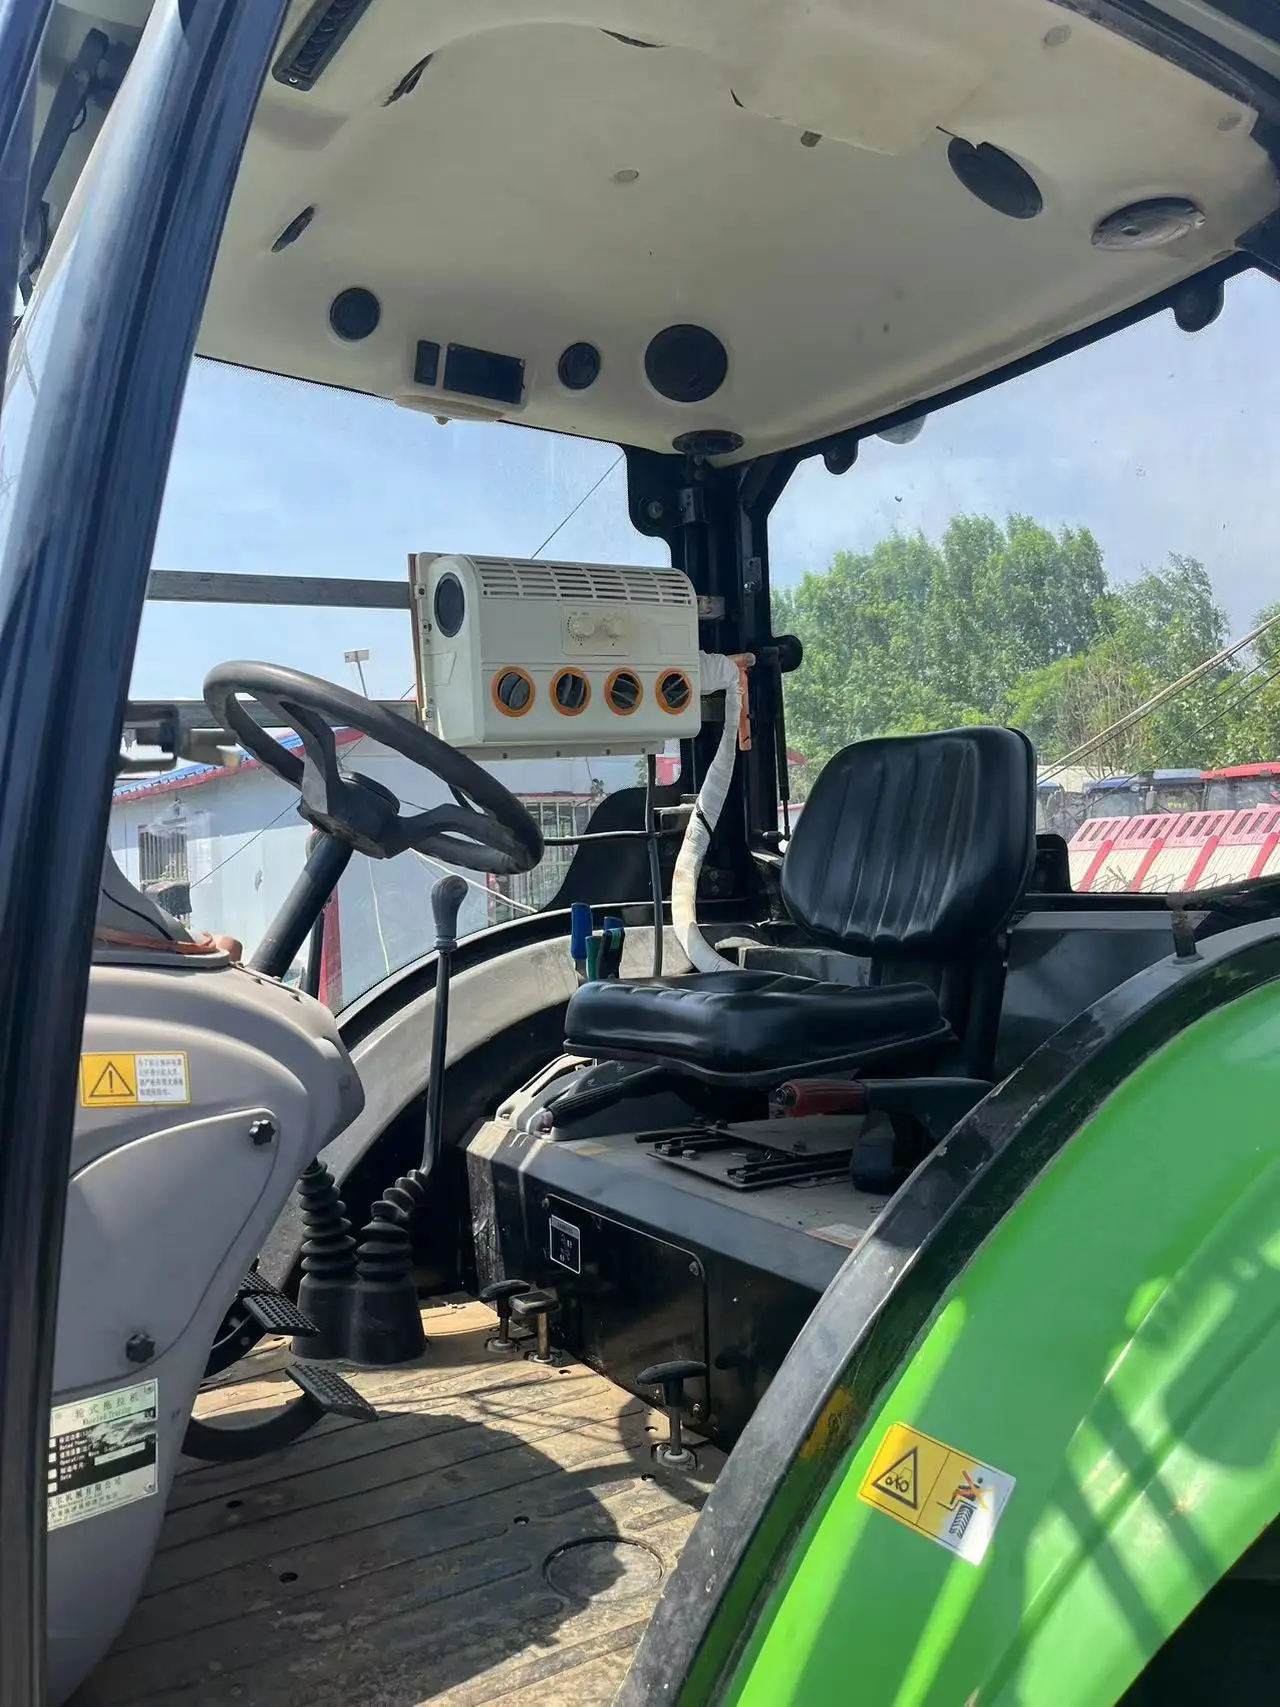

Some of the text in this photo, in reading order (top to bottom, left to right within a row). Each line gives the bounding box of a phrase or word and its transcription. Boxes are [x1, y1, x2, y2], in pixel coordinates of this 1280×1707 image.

[75, 1393, 140, 1419] 轮式拖拉机
